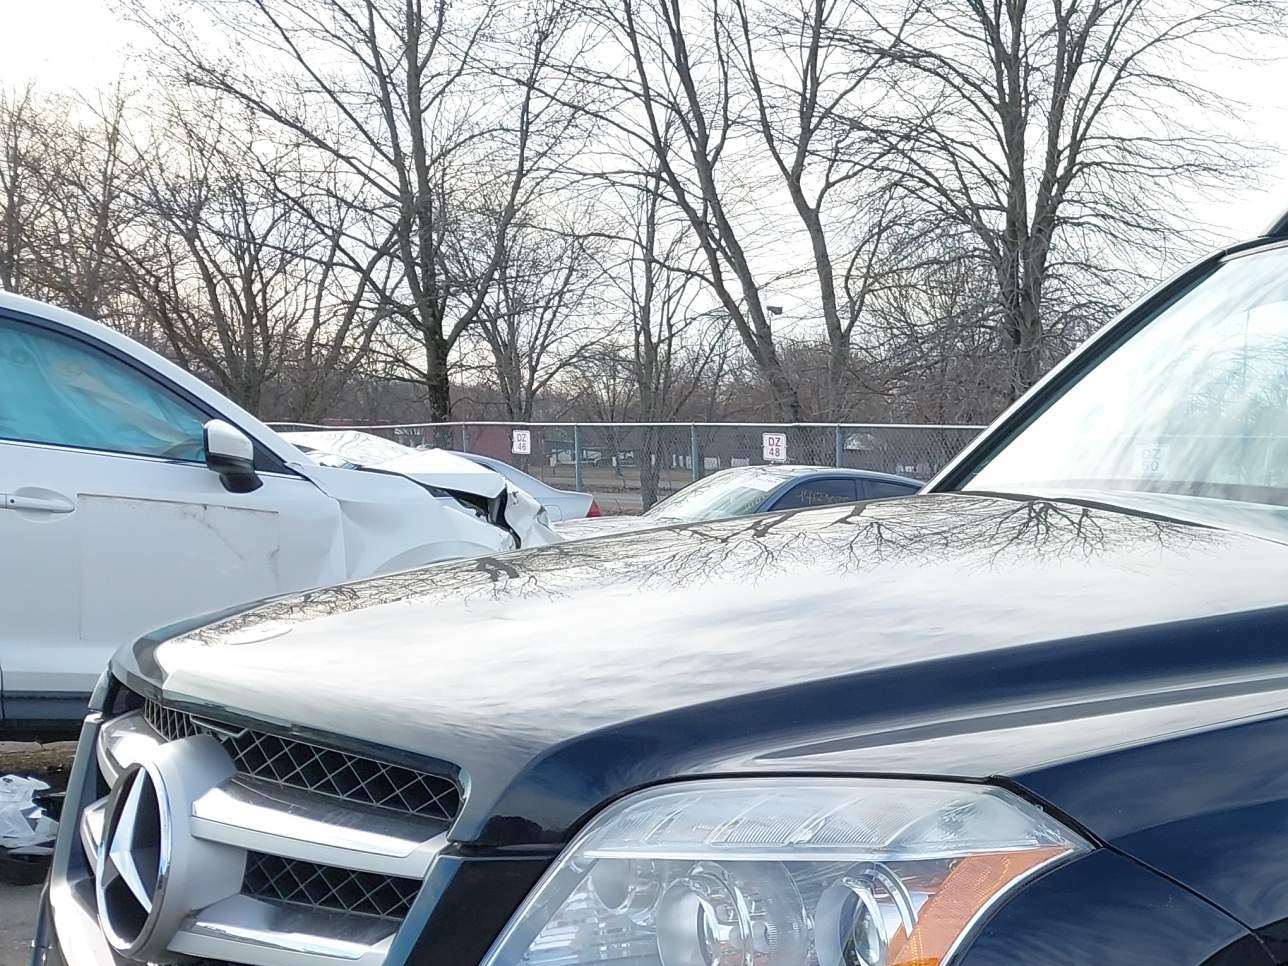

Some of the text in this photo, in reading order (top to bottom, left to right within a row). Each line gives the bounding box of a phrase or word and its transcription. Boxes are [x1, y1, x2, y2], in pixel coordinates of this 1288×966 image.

[516, 433, 527, 442] DZ
[768, 436, 781, 448] DZ
[768, 447, 781, 457] 48
